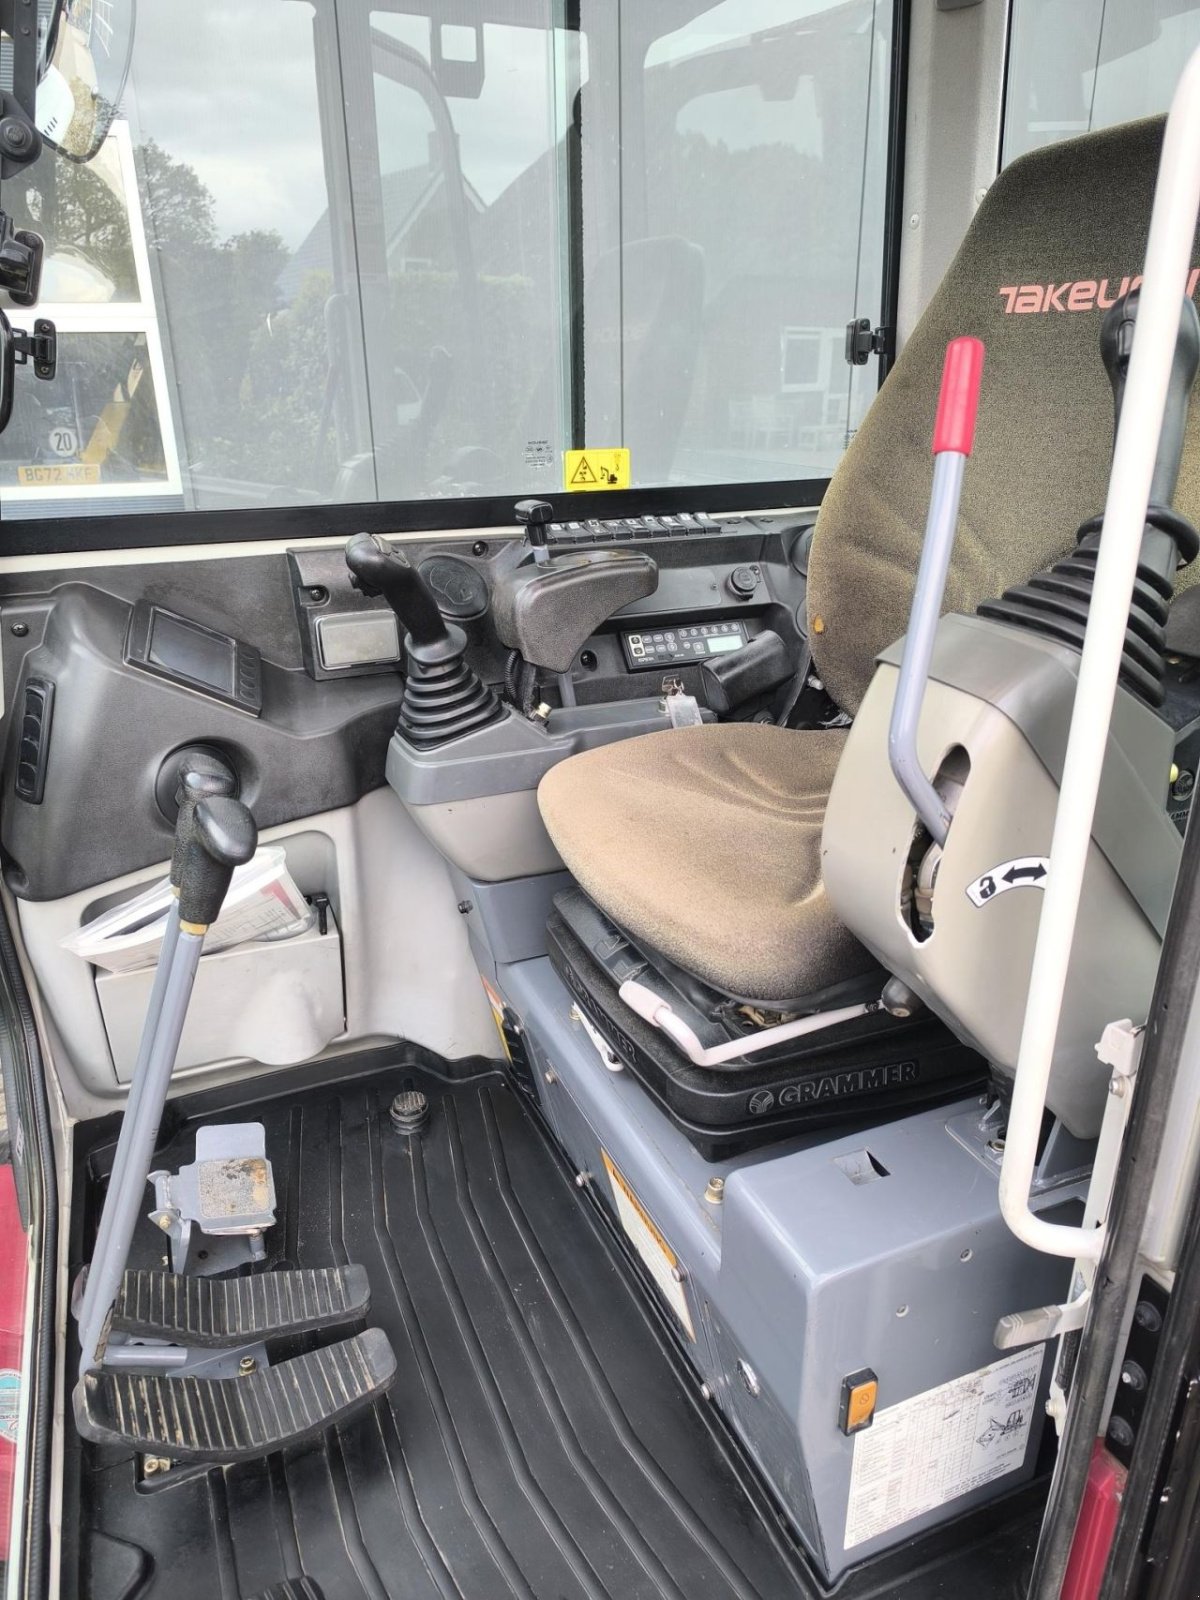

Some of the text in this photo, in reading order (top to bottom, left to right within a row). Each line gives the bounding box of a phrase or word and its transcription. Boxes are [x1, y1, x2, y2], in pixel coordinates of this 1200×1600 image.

[54, 432, 73, 451] 20
[25, 467, 62, 481] BG72
[778, 1062, 916, 1107] GRAMMER
